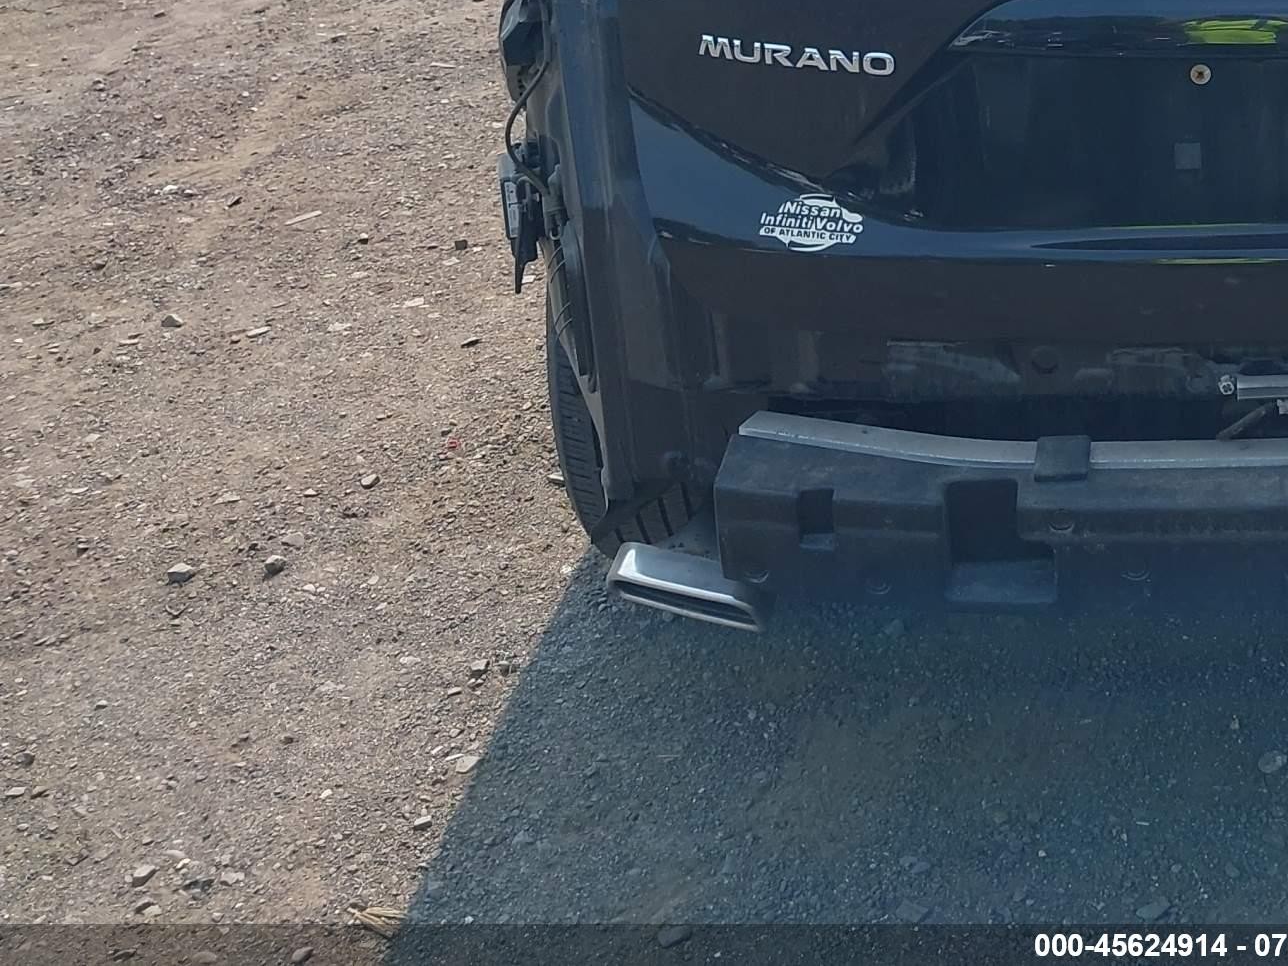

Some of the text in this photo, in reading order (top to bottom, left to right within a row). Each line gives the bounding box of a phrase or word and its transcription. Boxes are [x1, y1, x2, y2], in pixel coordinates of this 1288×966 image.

[698, 34, 895, 76] MURANO
[783, 201, 841, 218] Nissan
[779, 228, 826, 240] ATLANTIC
[829, 233, 853, 242] CITY
